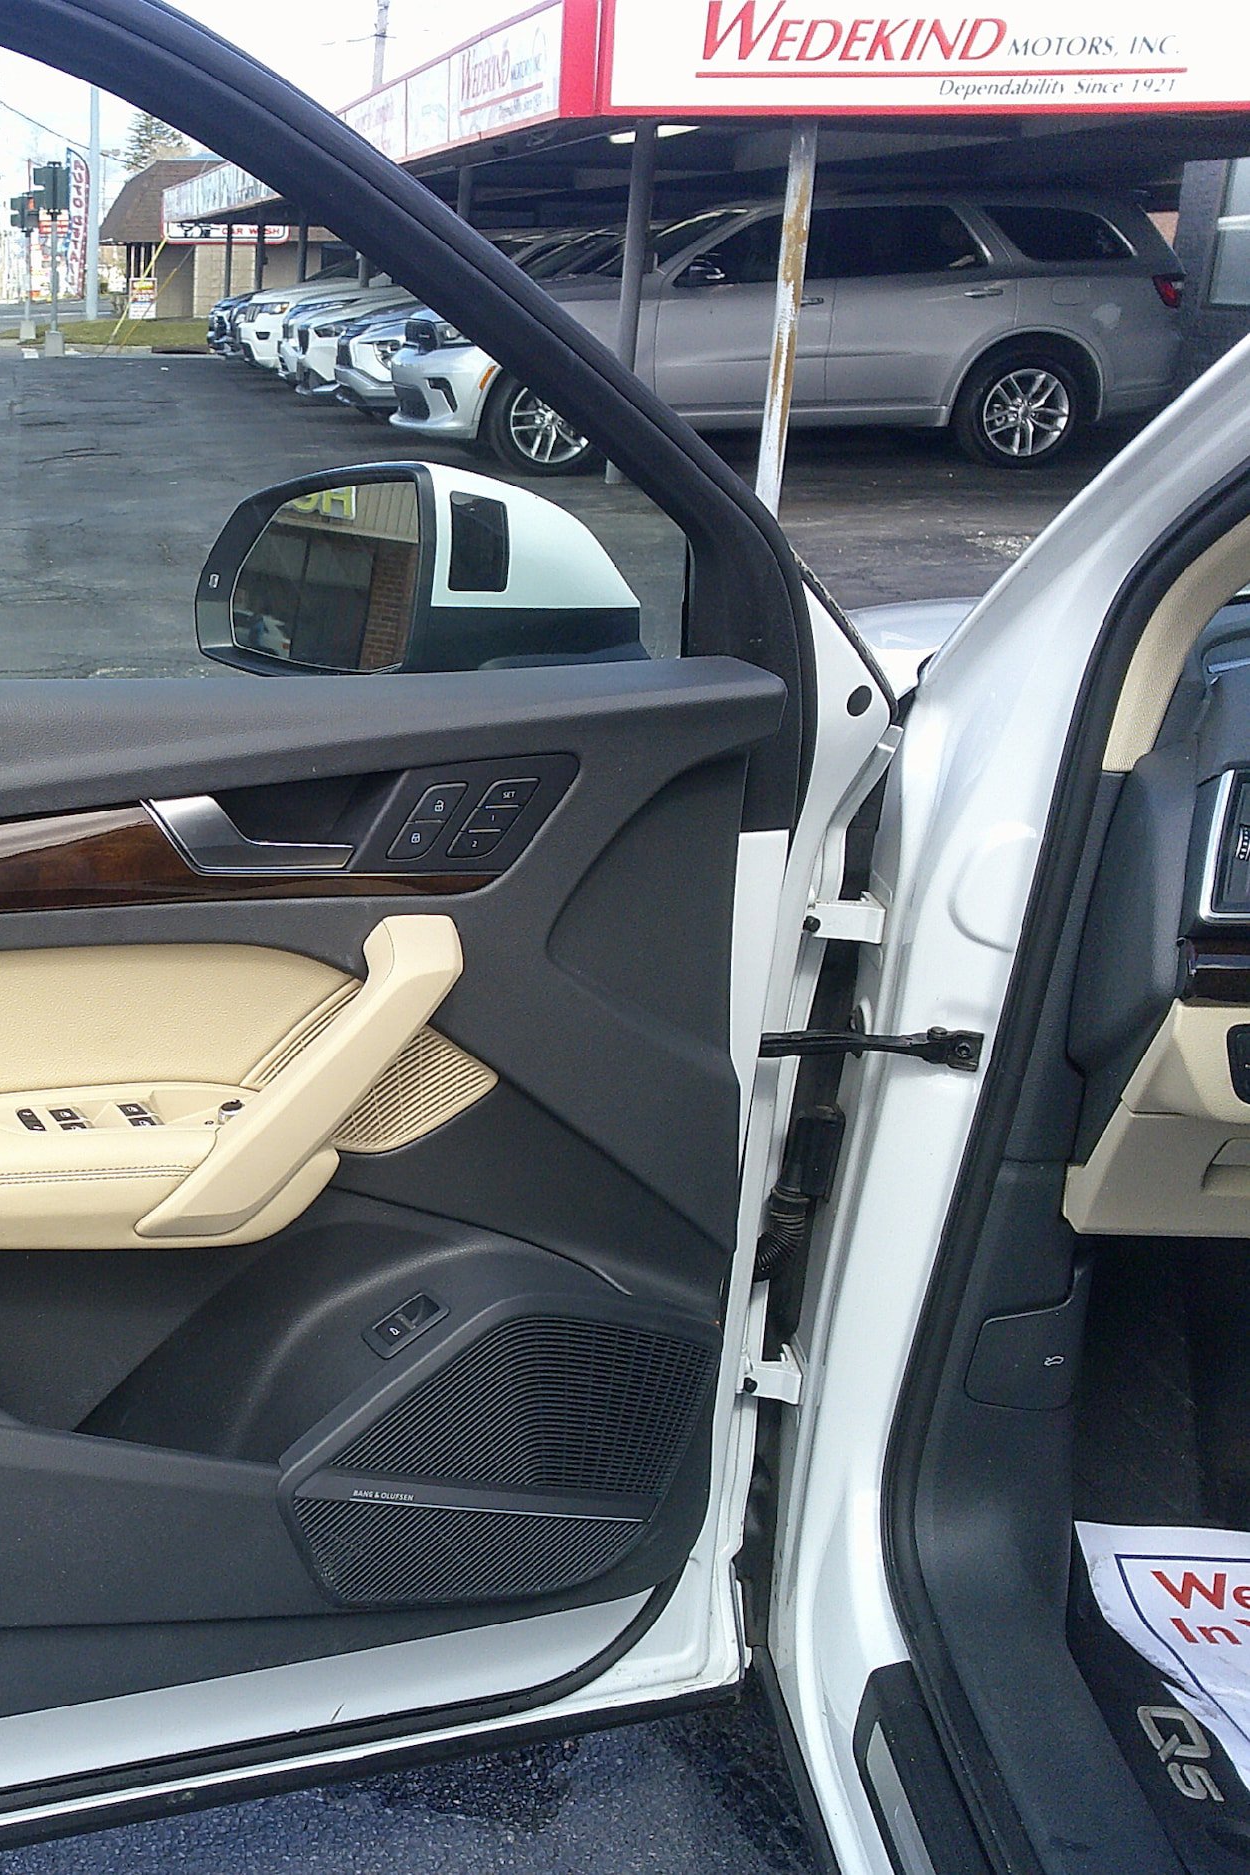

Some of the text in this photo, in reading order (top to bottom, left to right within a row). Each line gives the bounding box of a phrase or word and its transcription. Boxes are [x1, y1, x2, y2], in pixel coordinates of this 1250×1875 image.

[701, 0, 1180, 62] WEDEKIND MOTORS, INC.
[939, 78, 1176, 100] Dependability Since 1921
[353, 1490, 374, 1498] BANG
[381, 1492, 414, 1501] OLUFSEN
[1169, 1617, 1242, 1645] In
[1137, 1705, 1225, 1802] Q5
